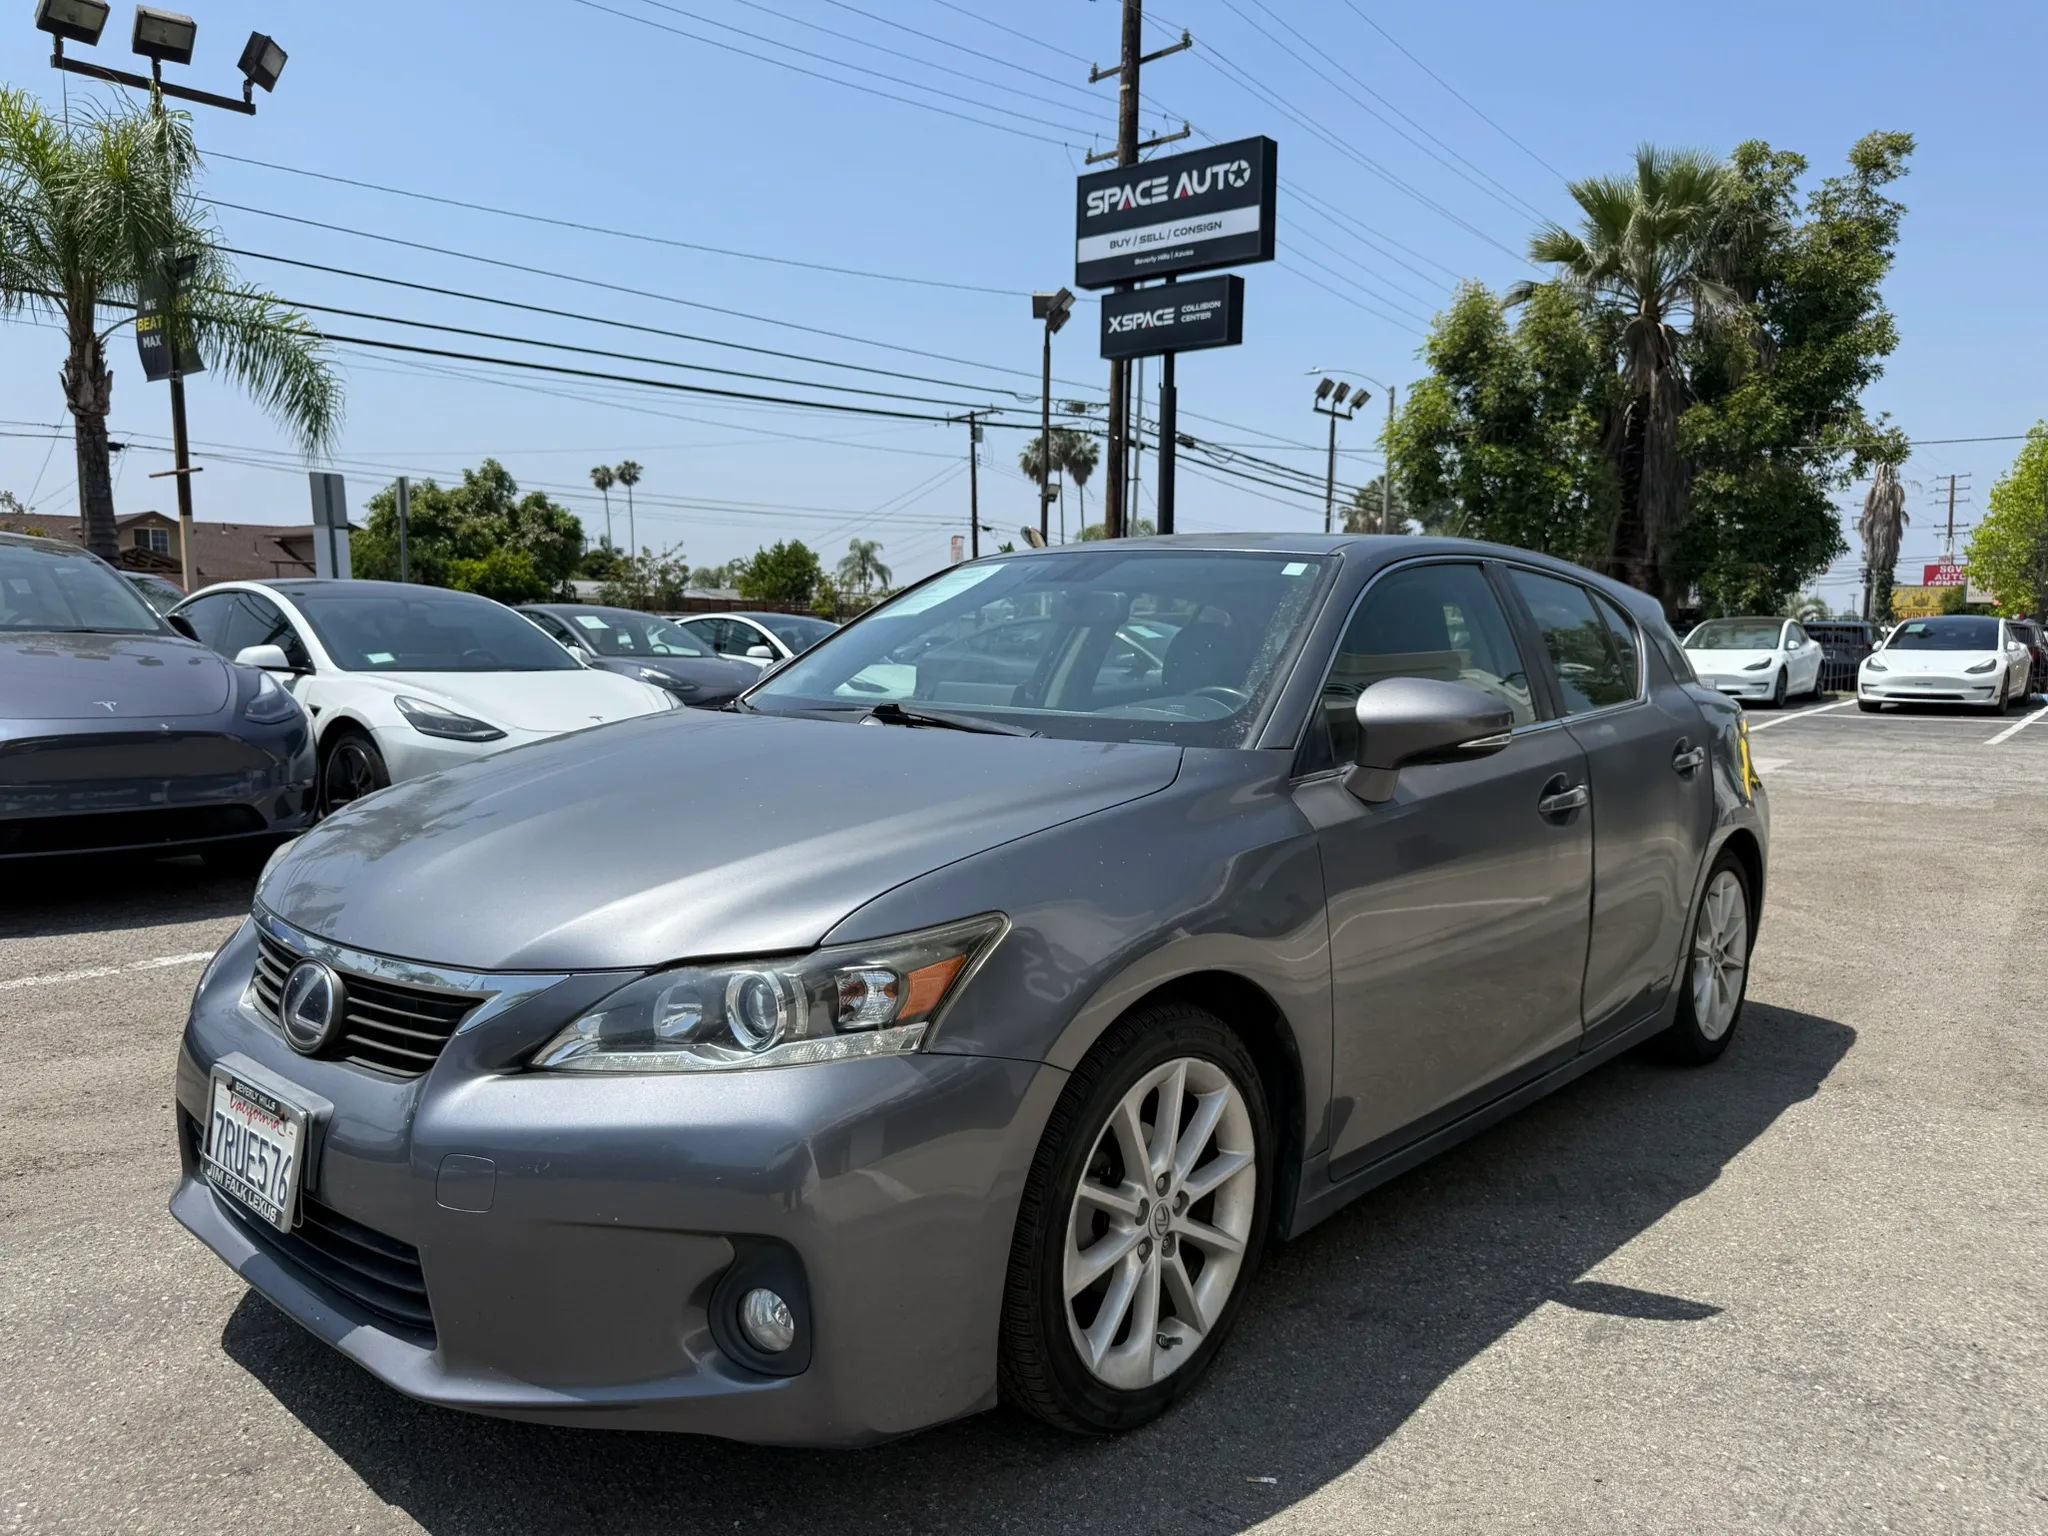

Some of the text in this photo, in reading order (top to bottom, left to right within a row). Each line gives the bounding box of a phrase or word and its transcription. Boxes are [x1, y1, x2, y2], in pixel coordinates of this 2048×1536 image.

[1086, 159, 1251, 217] SPACE AUTO
[1109, 237, 1132, 249] BUY
[1138, 232, 1166, 245] SELL
[1173, 220, 1223, 237] CONSIGN
[1108, 307, 1175, 334] XSPACE
[1181, 300, 1221, 313] COLLISION
[1181, 312, 1212, 323] CENTER
[137, 315, 163, 332] BEAT
[142, 334, 163, 349] MAX
[235, 1081, 277, 1112] BEVERLY HILLS
[215, 1111, 293, 1208] 7RUE576
[206, 1163, 278, 1224] JIM FALK LEXUS
